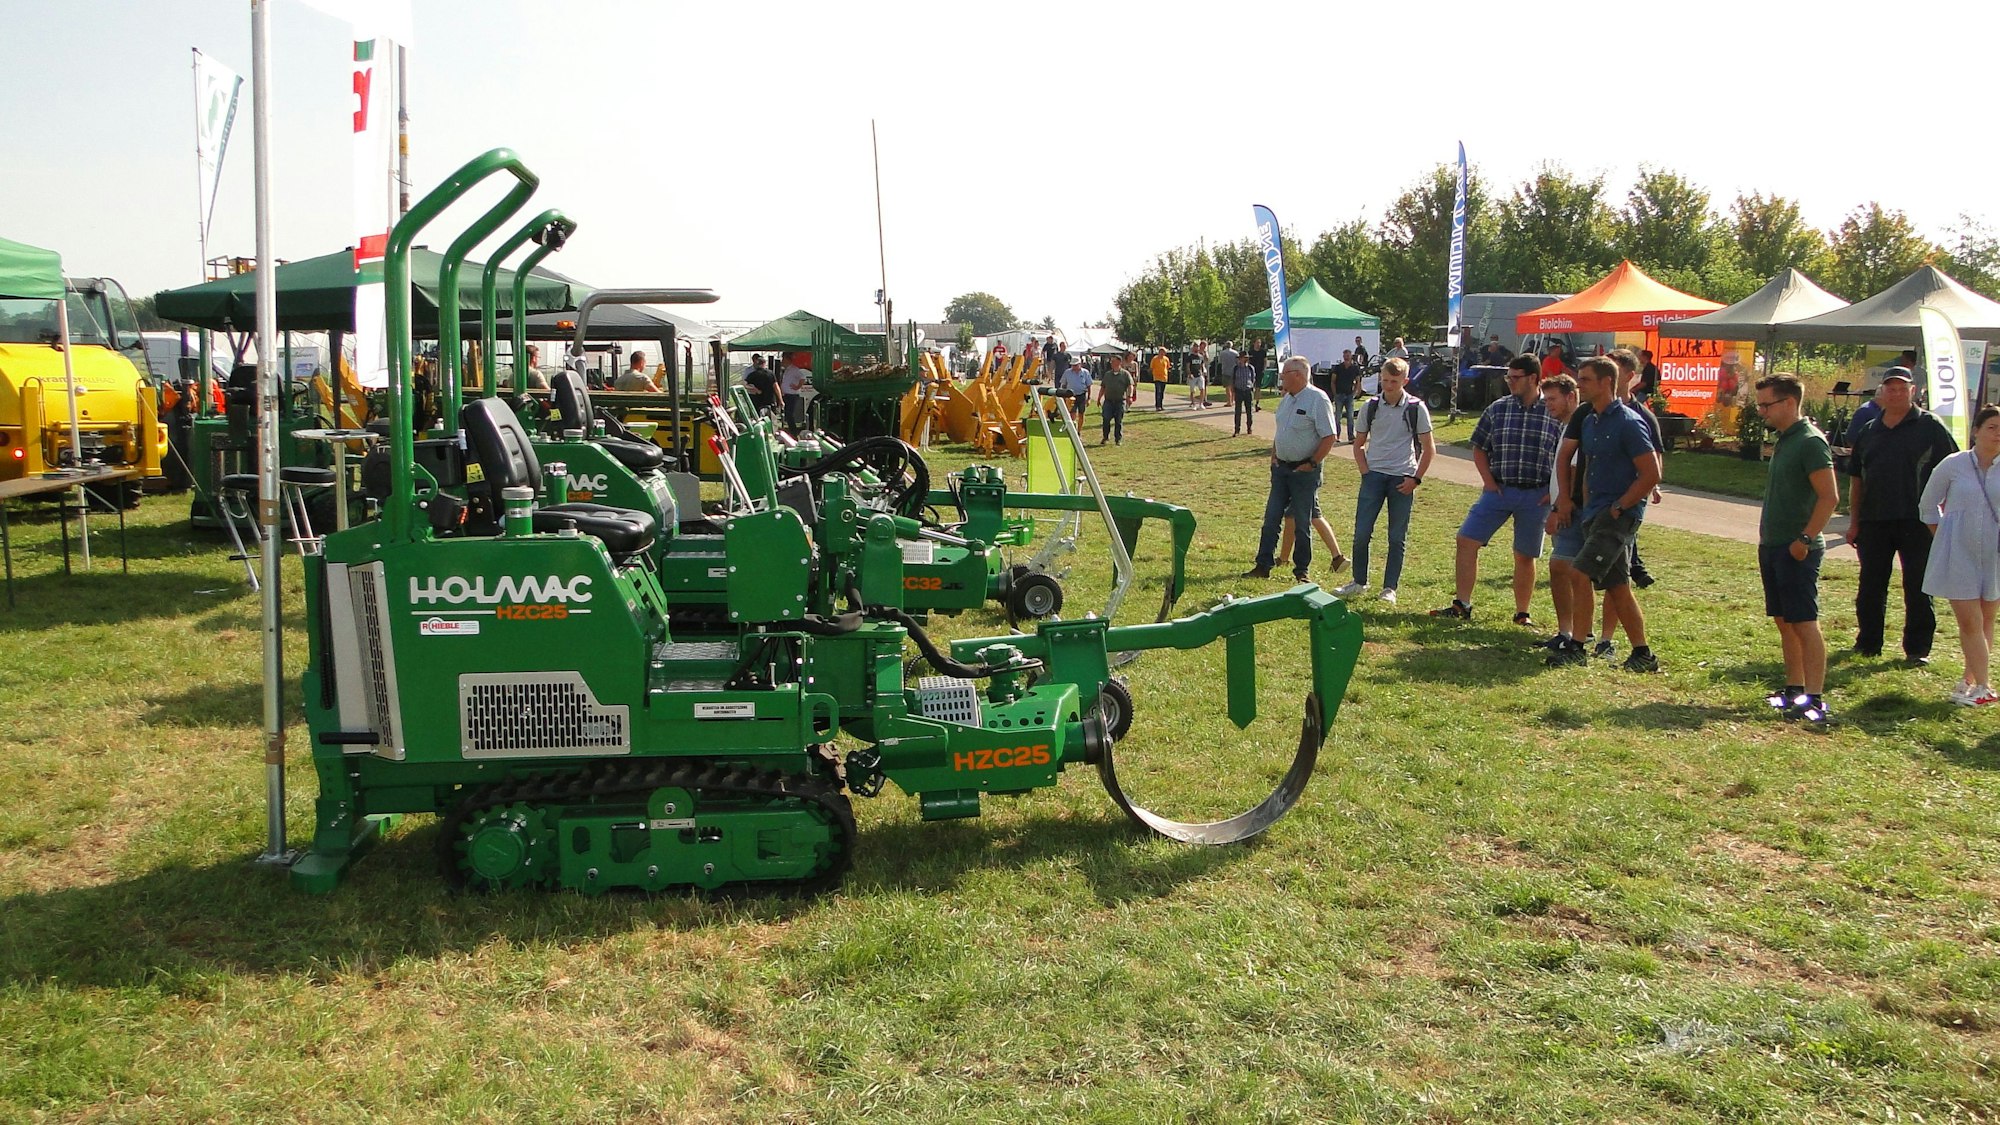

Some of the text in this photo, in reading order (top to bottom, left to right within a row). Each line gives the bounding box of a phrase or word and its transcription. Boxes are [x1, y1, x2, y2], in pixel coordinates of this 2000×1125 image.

[1539, 318, 1573, 330] Biolchim
[409, 575, 593, 604] HOLMAC
[496, 605, 569, 620] HZC25
[954, 744, 1051, 772] HZC25
